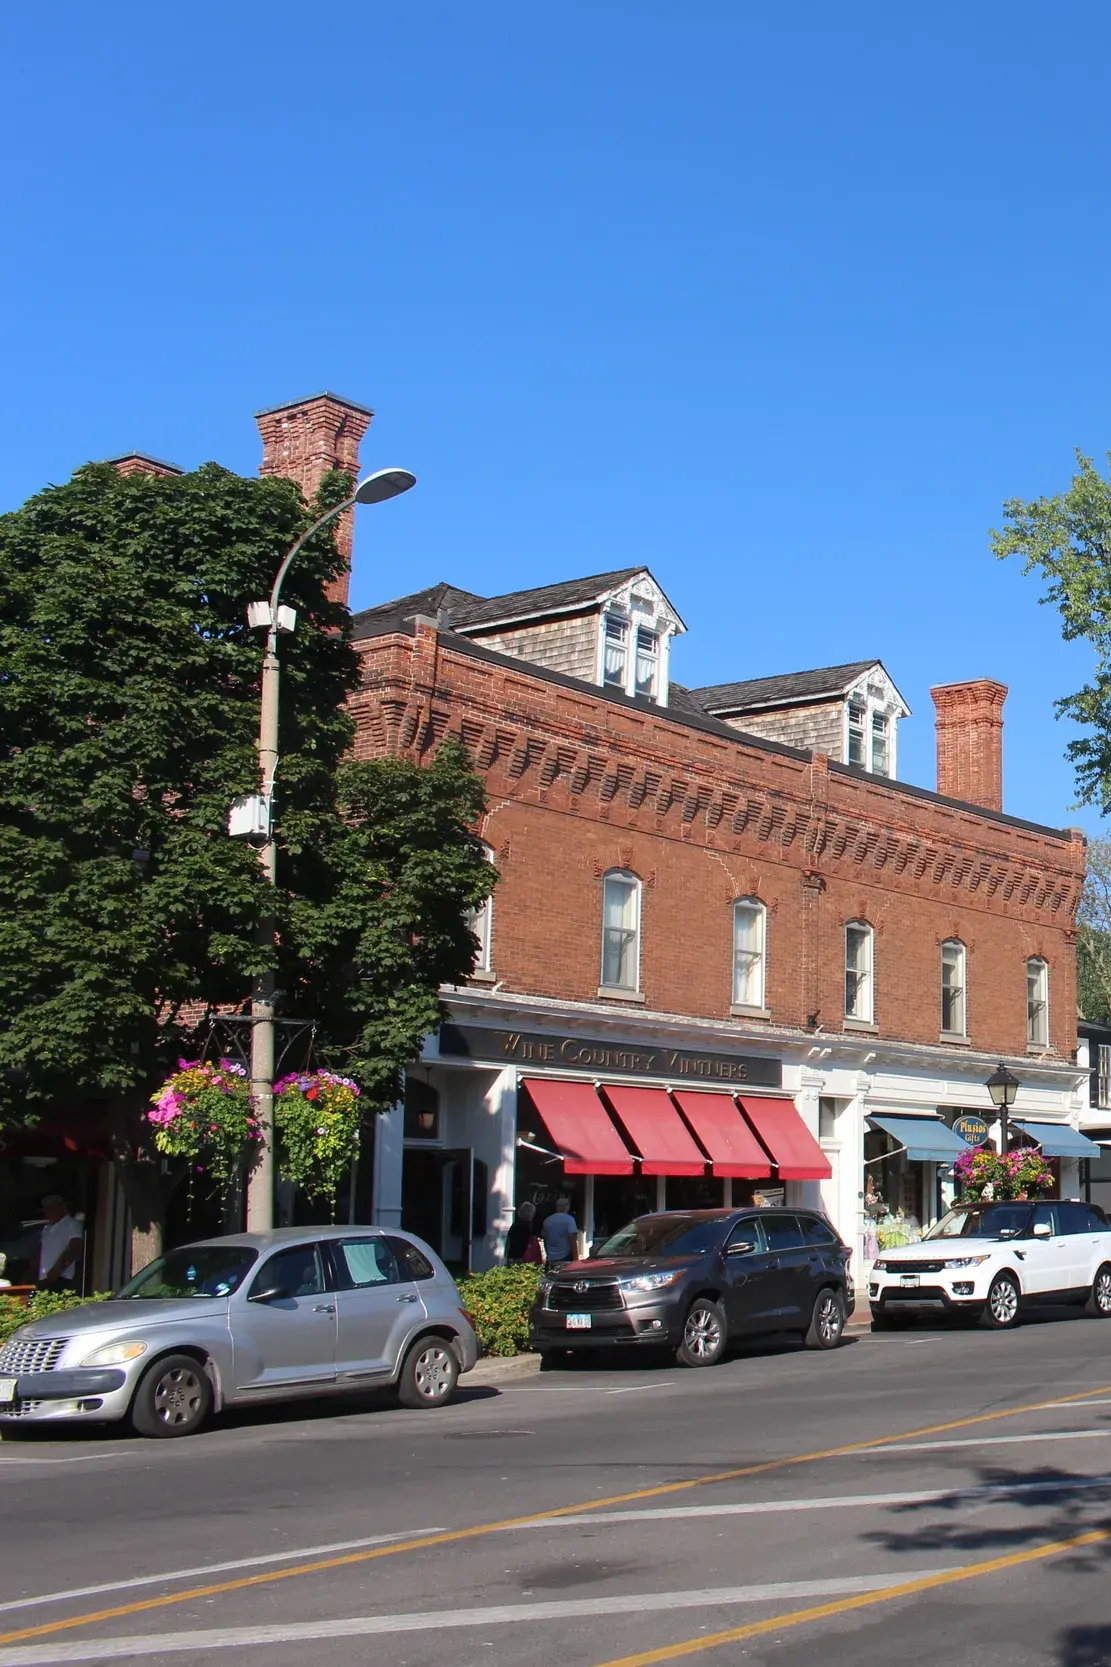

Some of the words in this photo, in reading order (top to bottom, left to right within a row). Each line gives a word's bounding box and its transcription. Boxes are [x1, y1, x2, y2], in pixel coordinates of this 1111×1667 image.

[495, 1031, 554, 1060] WINE
[561, 1039, 656, 1070] COUNTRY
[661, 1049, 748, 1080] VINTNERS
